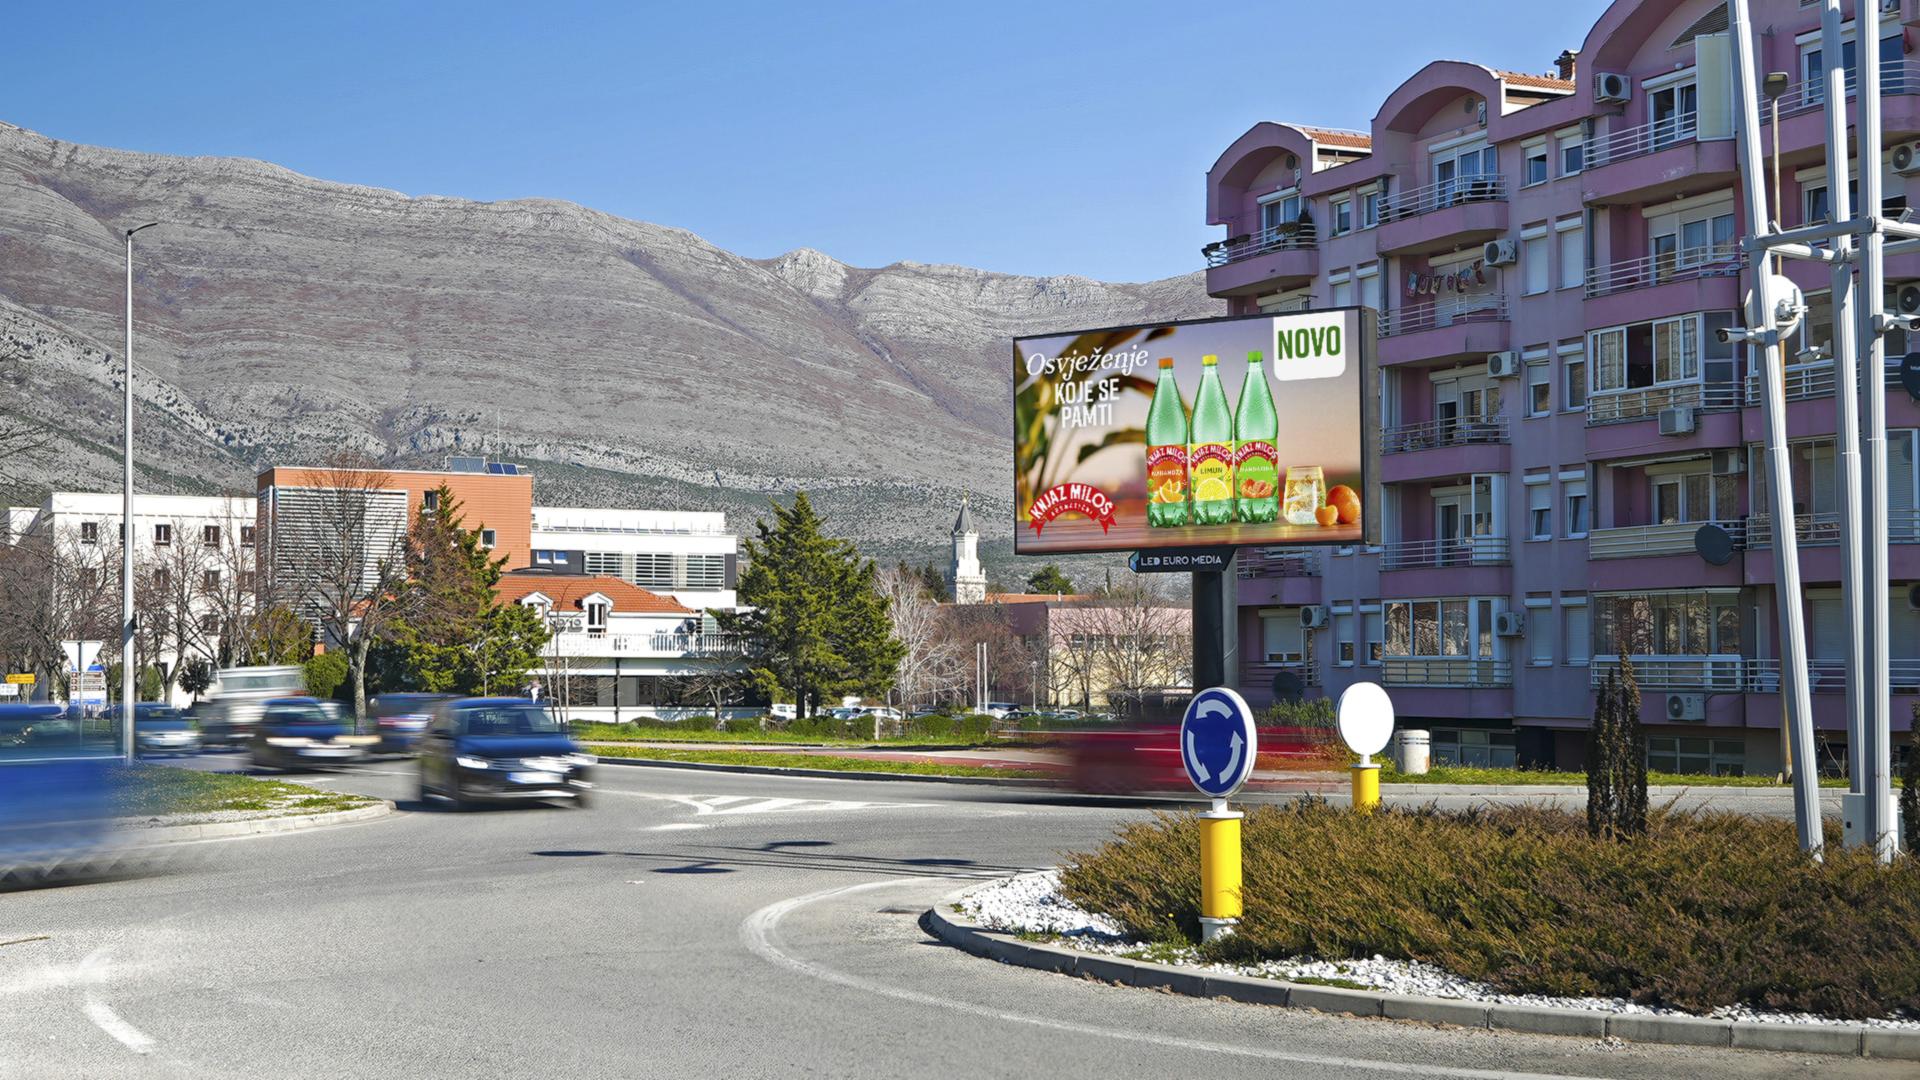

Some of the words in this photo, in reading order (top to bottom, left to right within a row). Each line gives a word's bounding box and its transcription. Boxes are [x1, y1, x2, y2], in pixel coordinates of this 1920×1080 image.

[1277, 325, 1341, 361] NOVO
[1026, 344, 1149, 381] Osvježenje
[1054, 381, 1094, 405] KOJE
[1098, 378, 1120, 401] SE
[1061, 403, 1113, 429] PAMTI
[1200, 466, 1223, 475] LIMUN
[1030, 485, 1068, 520] KNJAZ
[1140, 557, 1160, 566] LED
[1163, 555, 1189, 565] EURO
[1191, 555, 1222, 564] MEDIA
